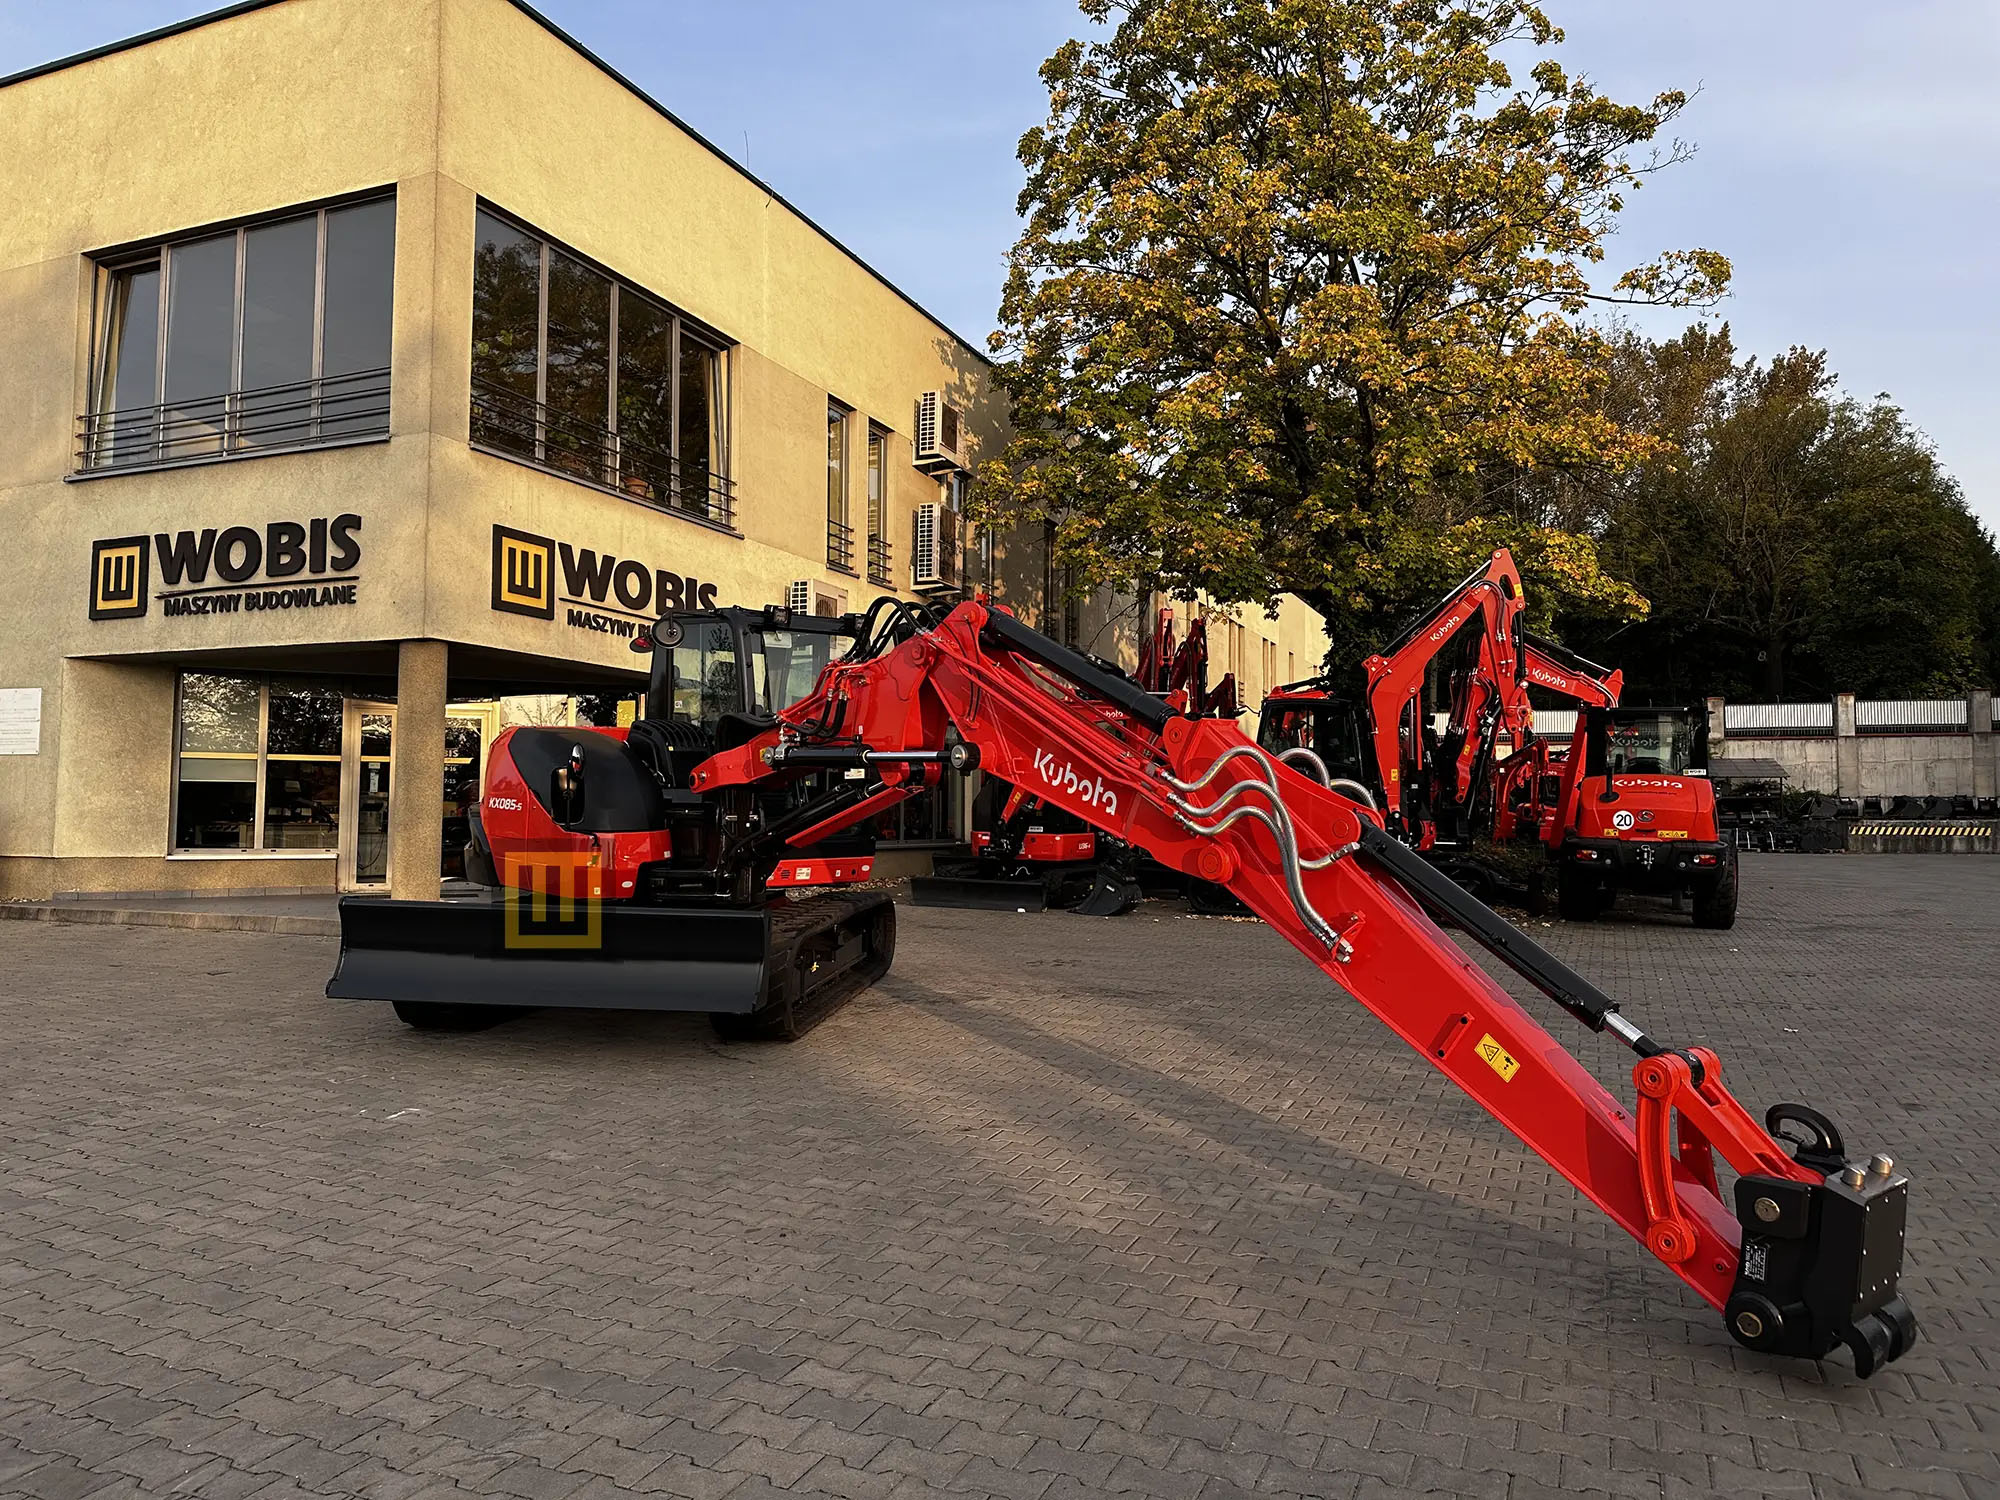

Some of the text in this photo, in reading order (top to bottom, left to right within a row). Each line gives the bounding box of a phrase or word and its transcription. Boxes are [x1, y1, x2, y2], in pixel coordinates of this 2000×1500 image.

[154, 513, 361, 584] WOBIS
[558, 542, 717, 615] WOBIS
[164, 585, 357, 616] MASZYNY BUDOWLANE
[567, 609, 636, 638] MASZYNY
[1430, 616, 1460, 642] Kubota
[1532, 668, 1567, 688] Kubota
[1105, 710, 1123, 718] bota
[1034, 748, 1117, 816] Kubota
[1612, 780, 1683, 789] Kubota
[1616, 814, 1632, 827] 20
